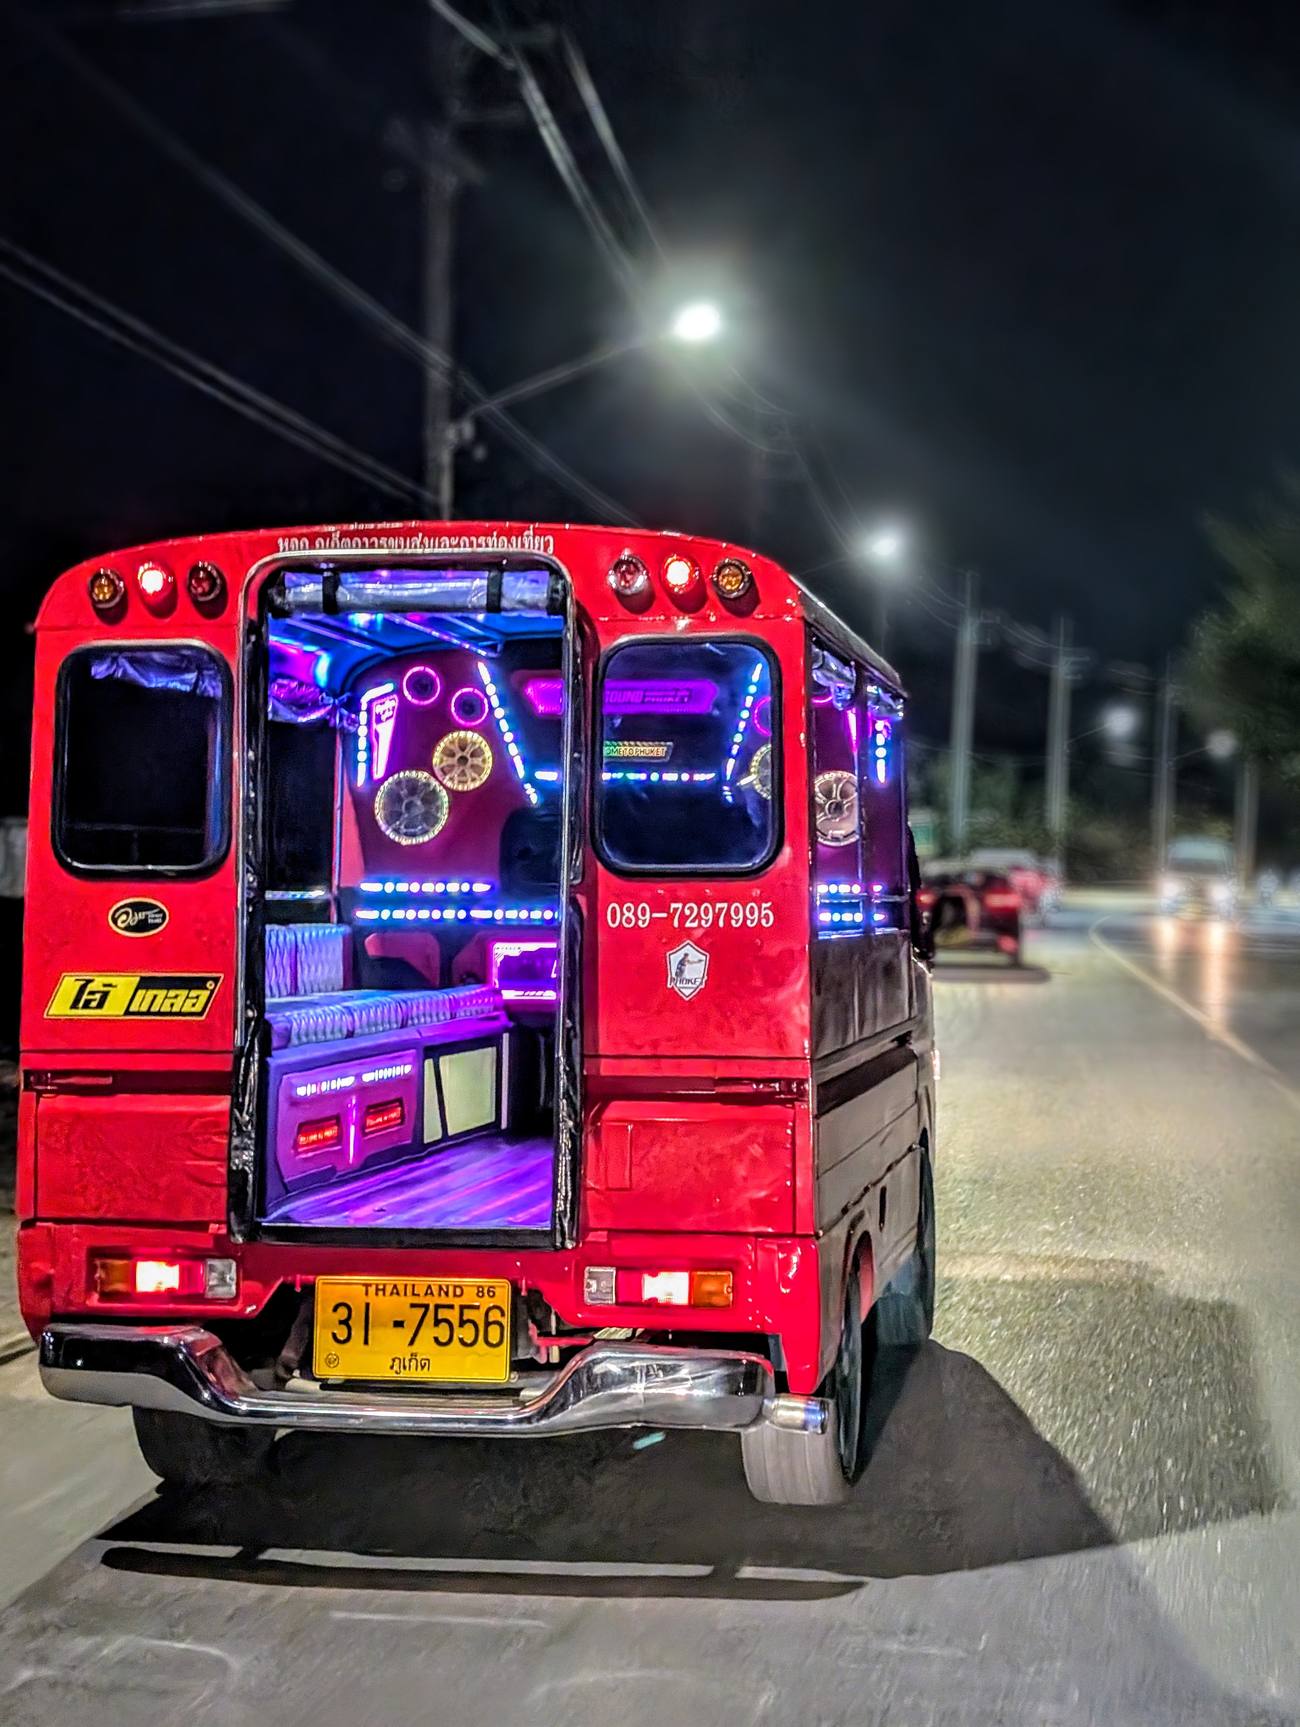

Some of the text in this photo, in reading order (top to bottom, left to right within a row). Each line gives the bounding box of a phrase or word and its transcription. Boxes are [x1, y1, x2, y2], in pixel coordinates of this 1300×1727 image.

[607, 902, 774, 928] 089-7297995
[362, 1283, 496, 1298] THAILAND 86
[389, 1352, 431, 1374] ภูเก็ต
